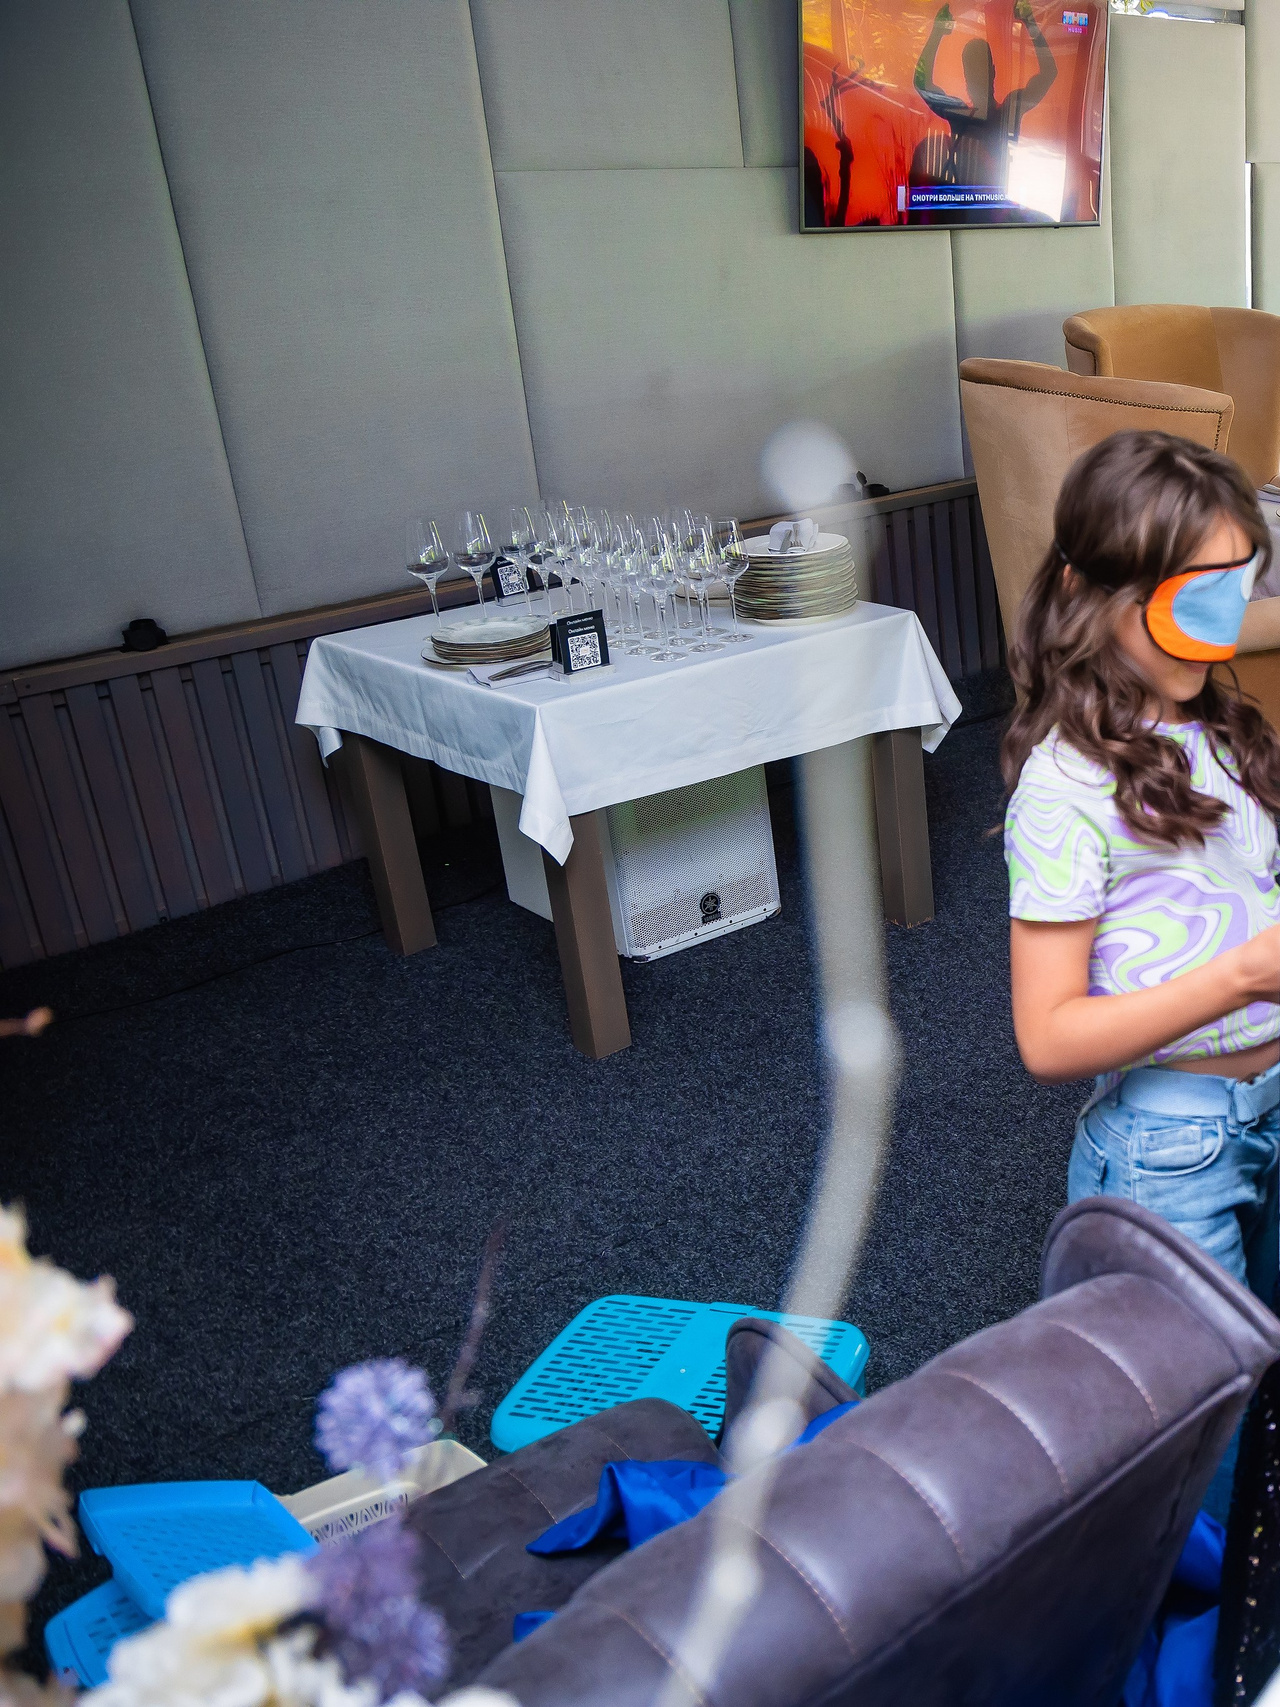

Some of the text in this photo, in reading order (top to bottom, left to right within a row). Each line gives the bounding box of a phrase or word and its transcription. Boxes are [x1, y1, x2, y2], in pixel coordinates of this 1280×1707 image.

[912, 194, 938, 202] СМОТРИ
[938, 194, 965, 202] БОЛЬШЕ
[965, 194, 975, 202] НА
